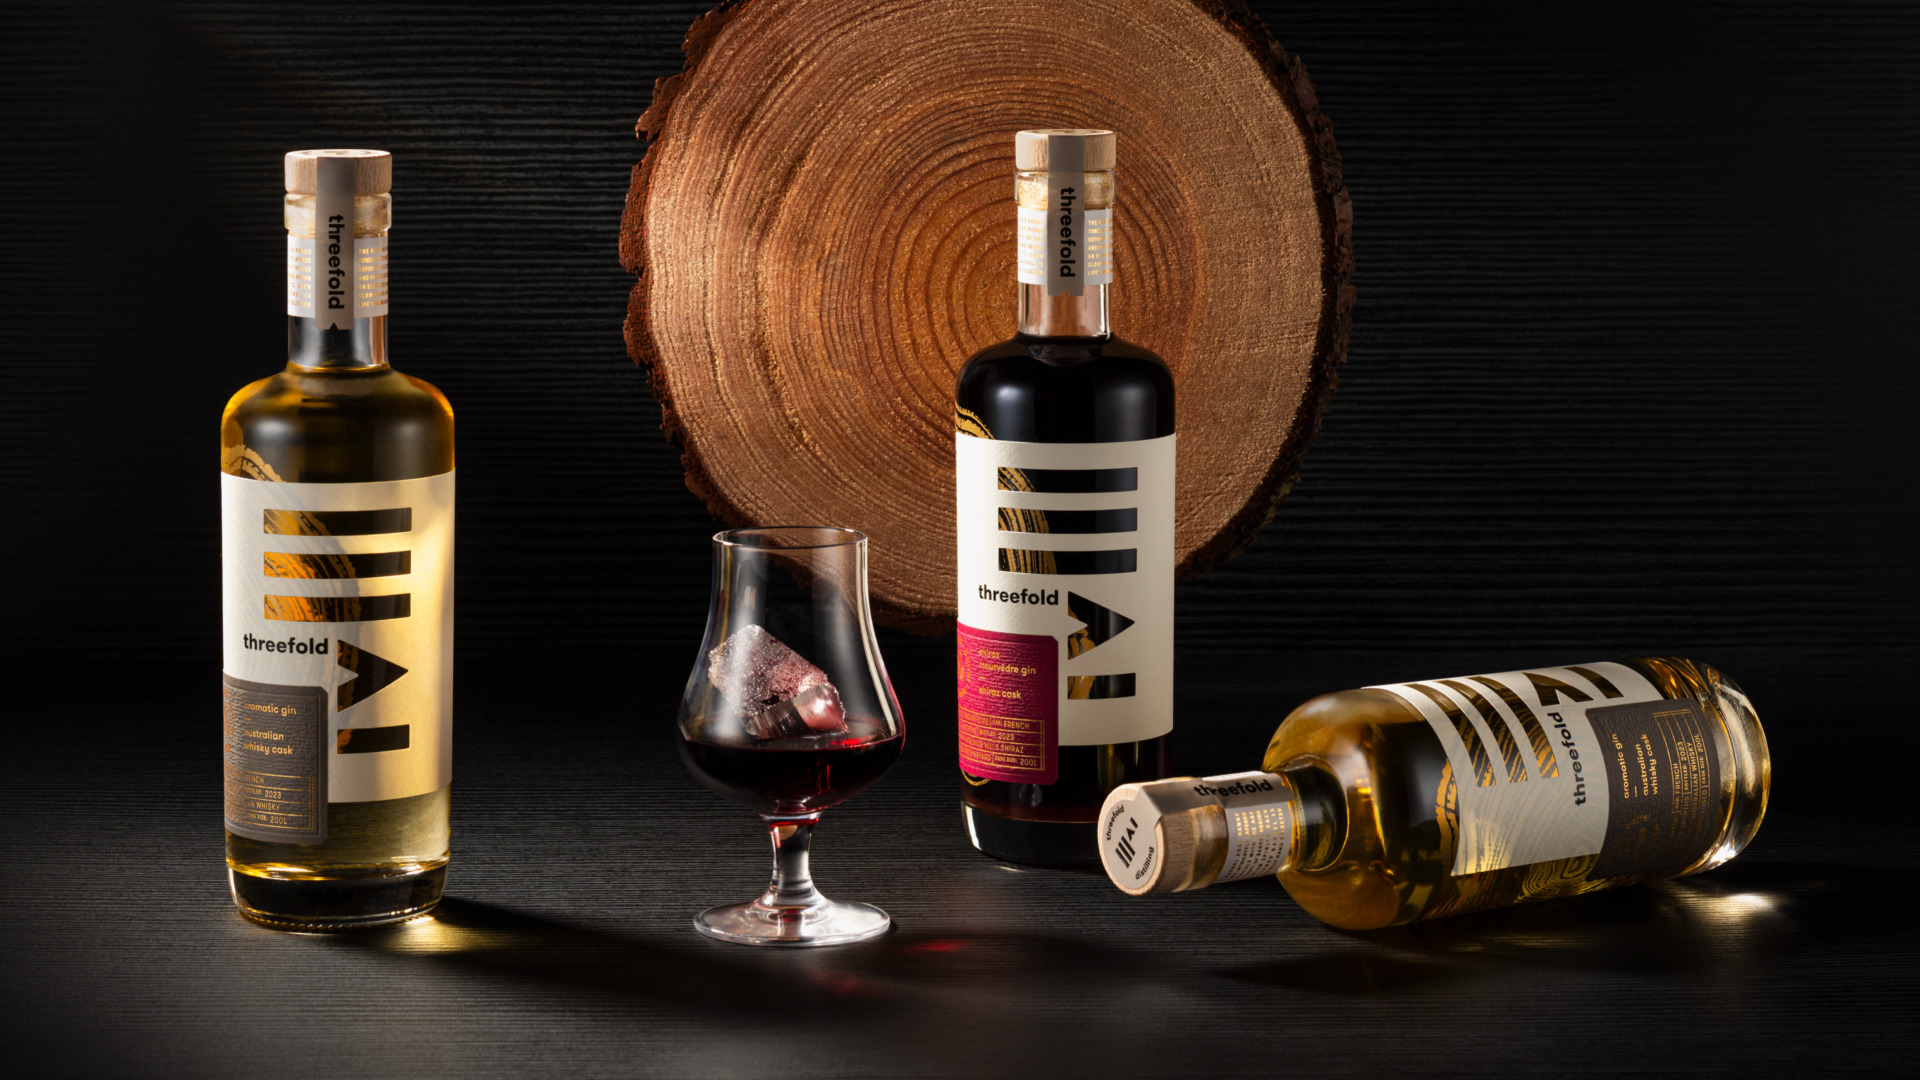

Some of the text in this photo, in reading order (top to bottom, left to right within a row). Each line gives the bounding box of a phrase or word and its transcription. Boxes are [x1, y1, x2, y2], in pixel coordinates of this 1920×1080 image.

[1060, 187, 1076, 277] threefold
[328, 215, 345, 309] threefold
[978, 584, 1059, 605] threefold
[243, 633, 328, 655] threefold
[979, 648, 1000, 658] shiraz
[1021, 665, 1036, 677] gin
[979, 686, 1021, 699] shiraz cask
[244, 702, 296, 717] aromatic gin
[244, 729, 284, 740] australian
[1004, 720, 1030, 730] FRENCH
[998, 732, 1015, 741] 2023
[1694, 734, 1704, 752] 200L
[244, 741, 293, 755] whisky cask
[1000, 744, 1024, 754] SHIRAZ
[1676, 741, 1688, 762] 2023
[1020, 758, 1037, 766] 200L
[1547, 712, 1587, 806] threefold
[1612, 733, 1629, 799] aromatic gin
[1641, 734, 1658, 795] whisky cask
[243, 774, 265, 784] FRENCH
[1635, 744, 1648, 796] australian
[1673, 763, 1681, 794] FRENCH
[1681, 763, 1690, 791] BOTTLED:
[1194, 779, 1274, 797] threefold
[1687, 742, 1700, 820] AUSTRALIAN WHISKY
[265, 790, 282, 799] 2023
[256, 801, 281, 811] WHISKY
[1270, 808, 1276, 816] IS
[270, 815, 287, 825] 200L
[1106, 804, 1125, 841] threefold
[1234, 813, 1243, 836] RANGE
[1241, 812, 1250, 838] LAYERED
[1256, 810, 1264, 832] AGEING
[1263, 809, 1271, 828] EACH
[1256, 835, 1264, 856] BARREL
[1276, 842, 1284, 858] HAND
[1135, 846, 1154, 880] distilling
